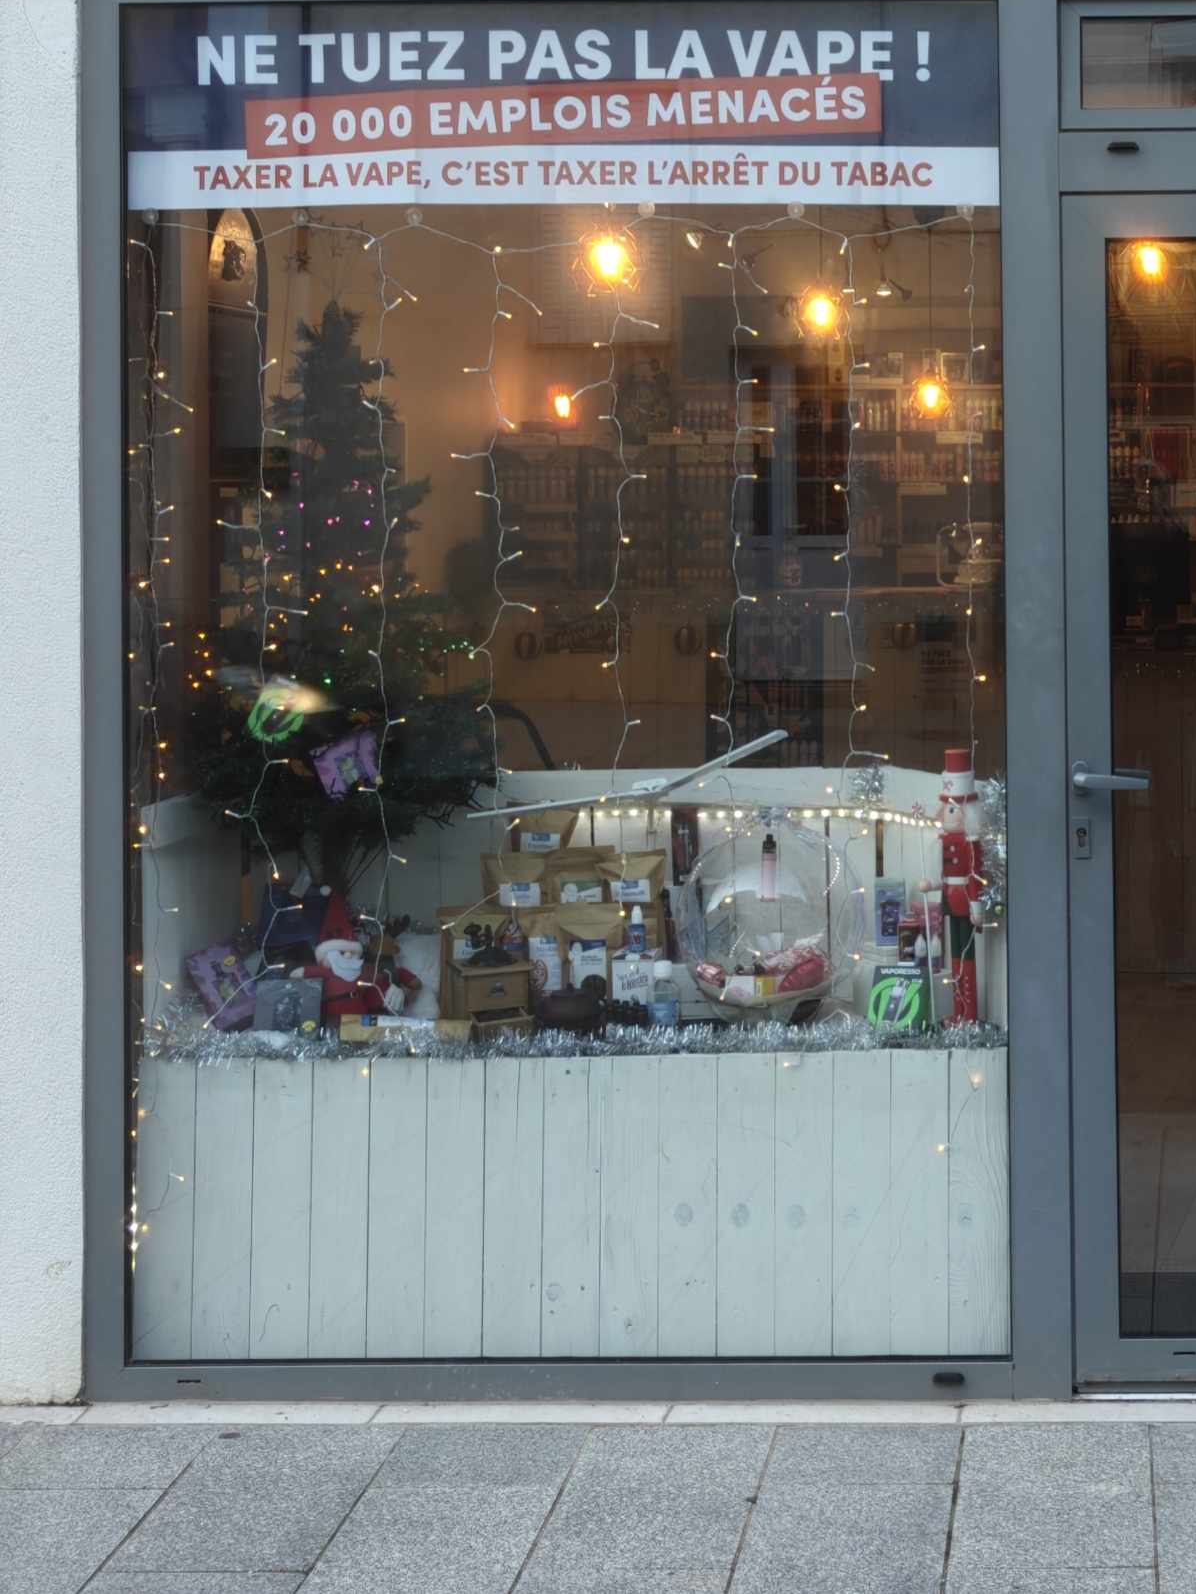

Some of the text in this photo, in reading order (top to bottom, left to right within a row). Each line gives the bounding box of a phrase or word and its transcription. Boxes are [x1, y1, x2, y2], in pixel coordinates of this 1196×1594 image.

[197, 29, 932, 86] NE TUEZ PAS LA VAPE !
[264, 76, 867, 146] 20 000 EMPLOIS MENACÉS
[193, 152, 934, 191] TAXER LA VAPE, C'EST TAXER L'ARRÊT DU TABAC
